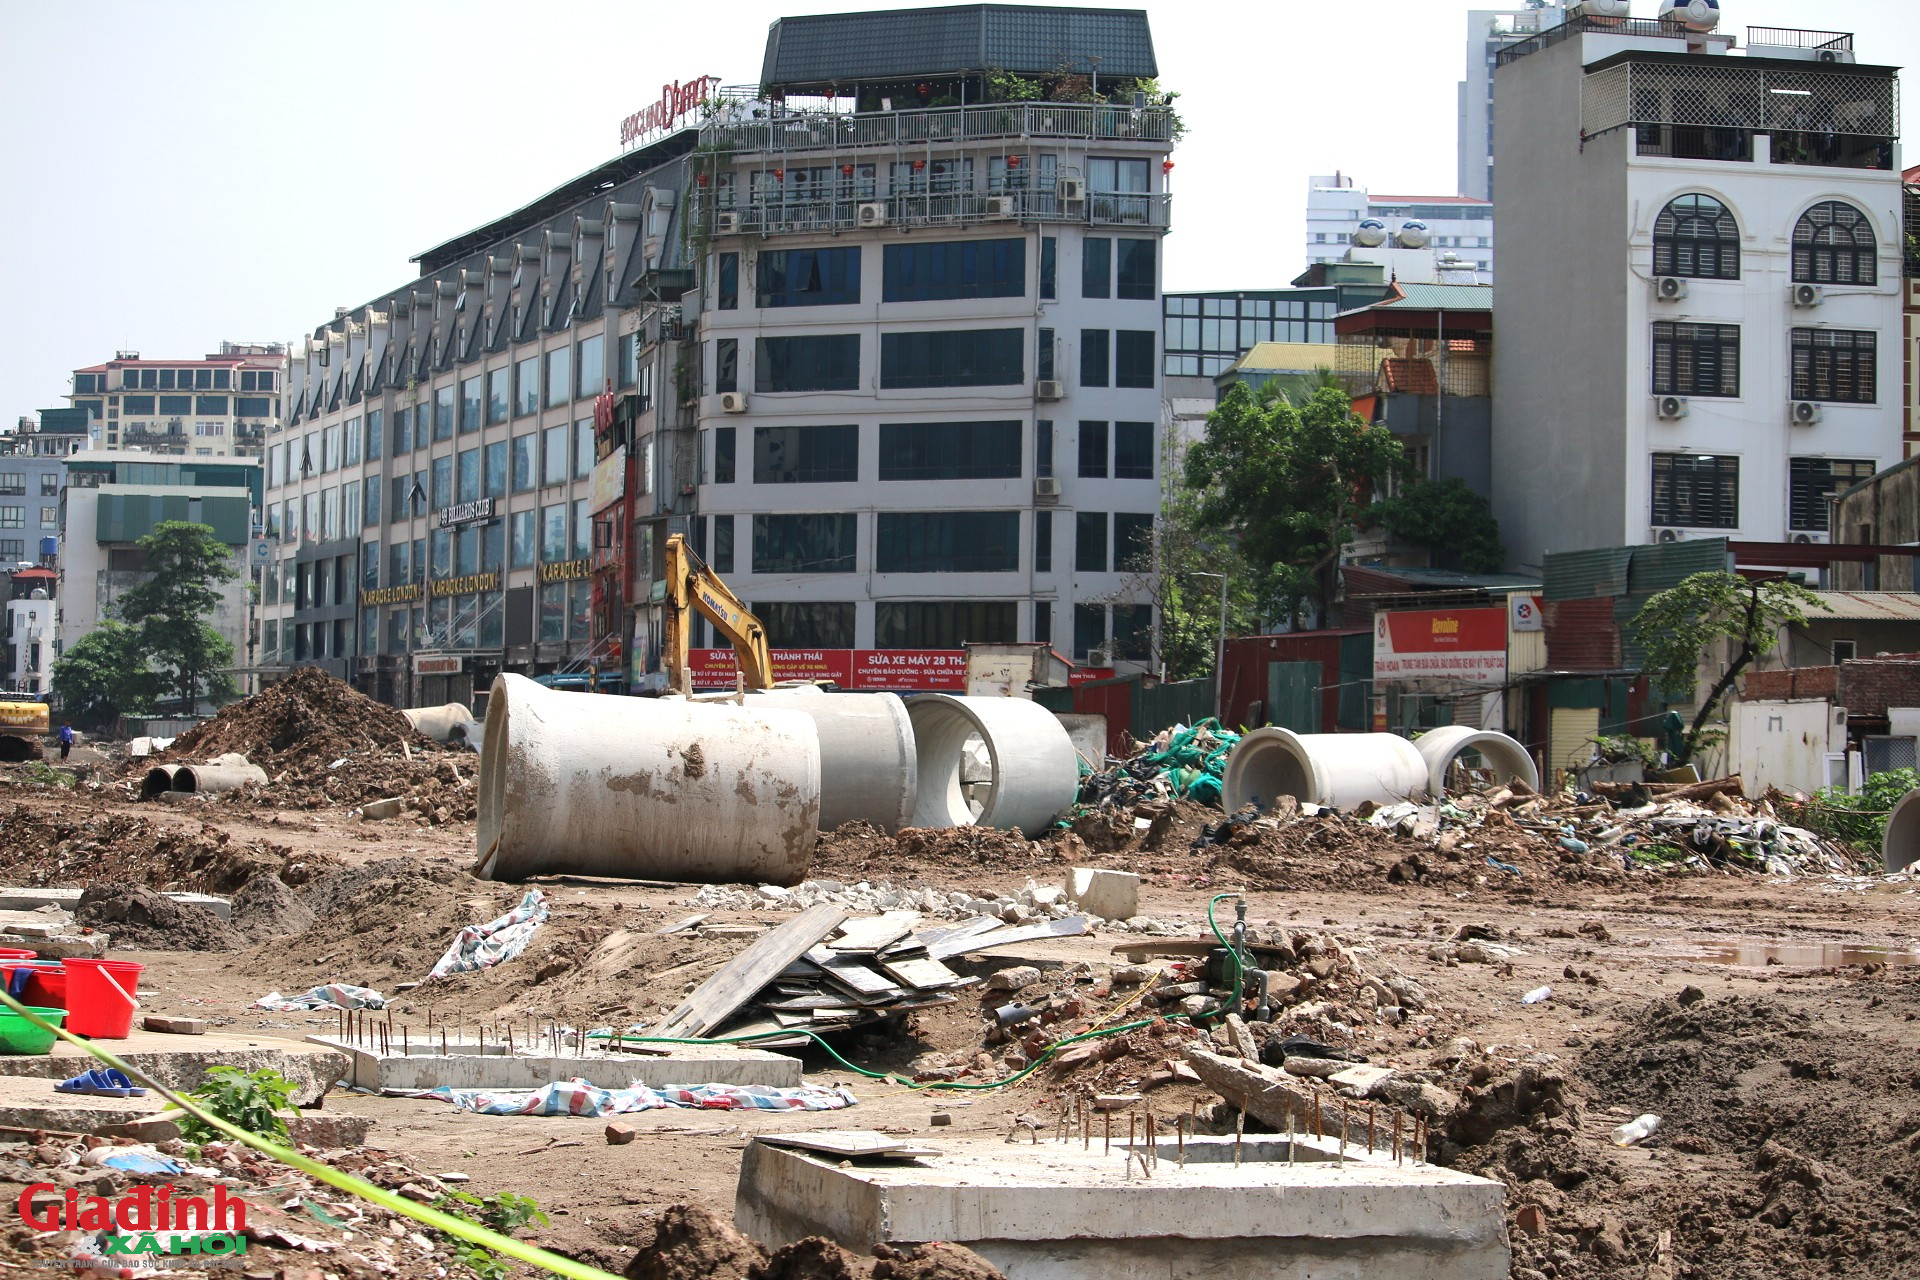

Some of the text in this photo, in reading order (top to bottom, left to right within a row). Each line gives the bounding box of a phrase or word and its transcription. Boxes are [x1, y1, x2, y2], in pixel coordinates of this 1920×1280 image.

[543, 560, 582, 581] KARAOKE
[363, 583, 420, 606] KARAOKE LONDON
[432, 572, 496, 597] KARAOKE LONDON
[703, 592, 728, 621] KOMATSU
[1432, 617, 1459, 634] Havoline
[868, 653, 890, 665] SỬA
[892, 656, 906, 665] XE
[908, 655, 931, 665] MÁY
[933, 656, 946, 666] 28
